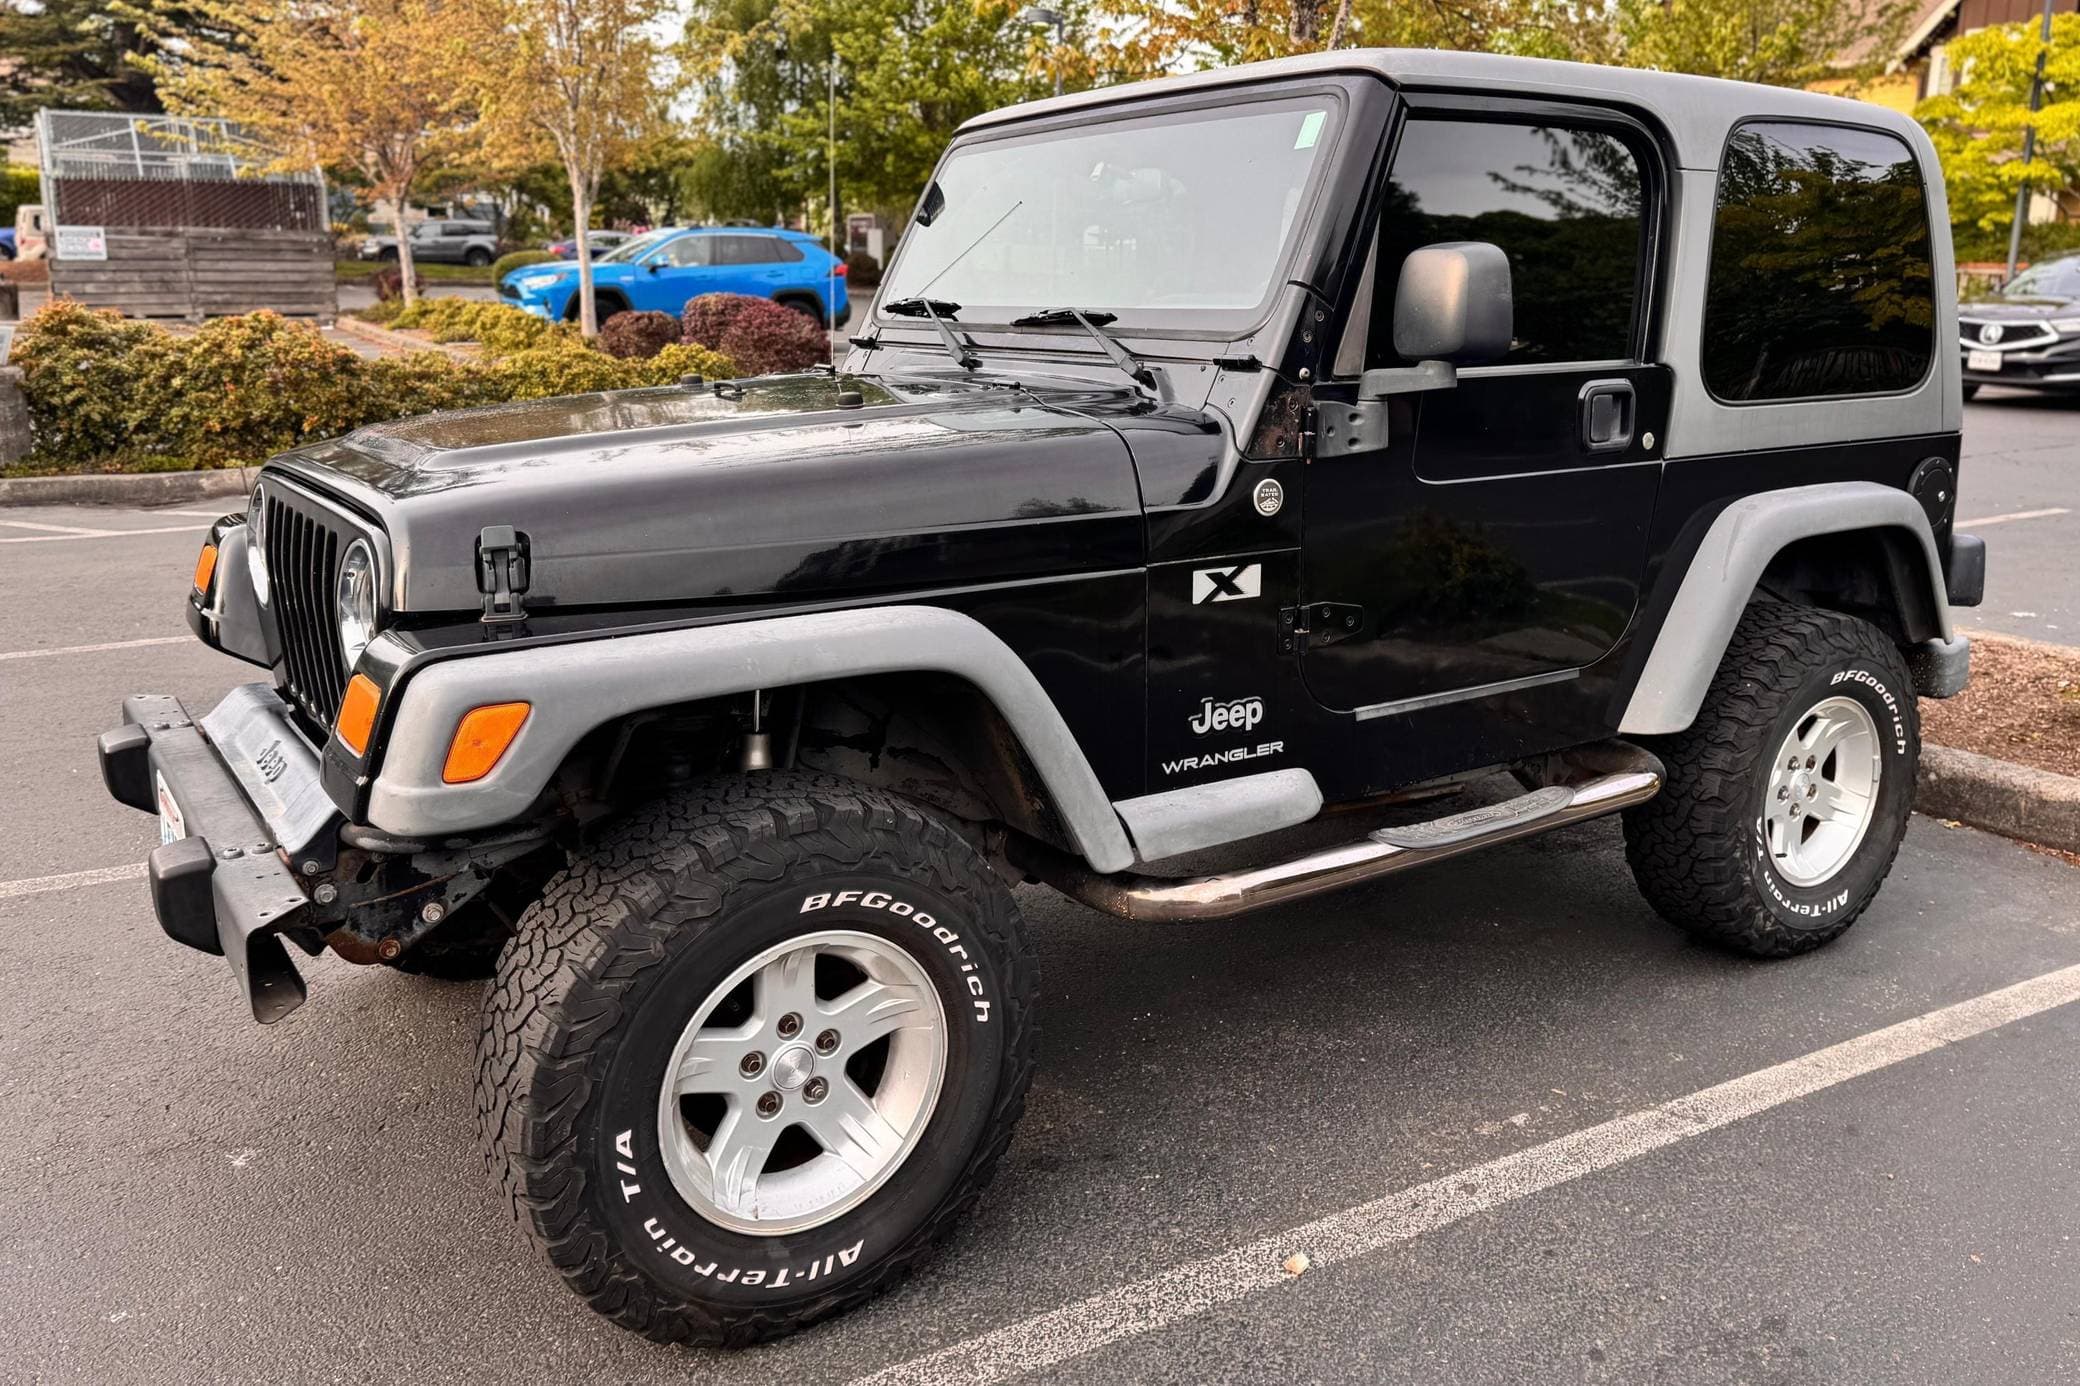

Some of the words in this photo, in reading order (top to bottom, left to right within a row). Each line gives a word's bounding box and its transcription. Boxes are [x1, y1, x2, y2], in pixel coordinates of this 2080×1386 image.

[1197, 564, 1253, 605] X
[1190, 697, 1263, 735] Jeep
[1830, 669, 1905, 756] BFGoodrich
[1161, 740, 1284, 775] WRANGLER
[1764, 870, 1849, 918] All-Terrain
[798, 890, 991, 1023] BFGoodrich
[614, 1127, 642, 1204] T/A
[642, 1216, 866, 1289] All-Terrain
